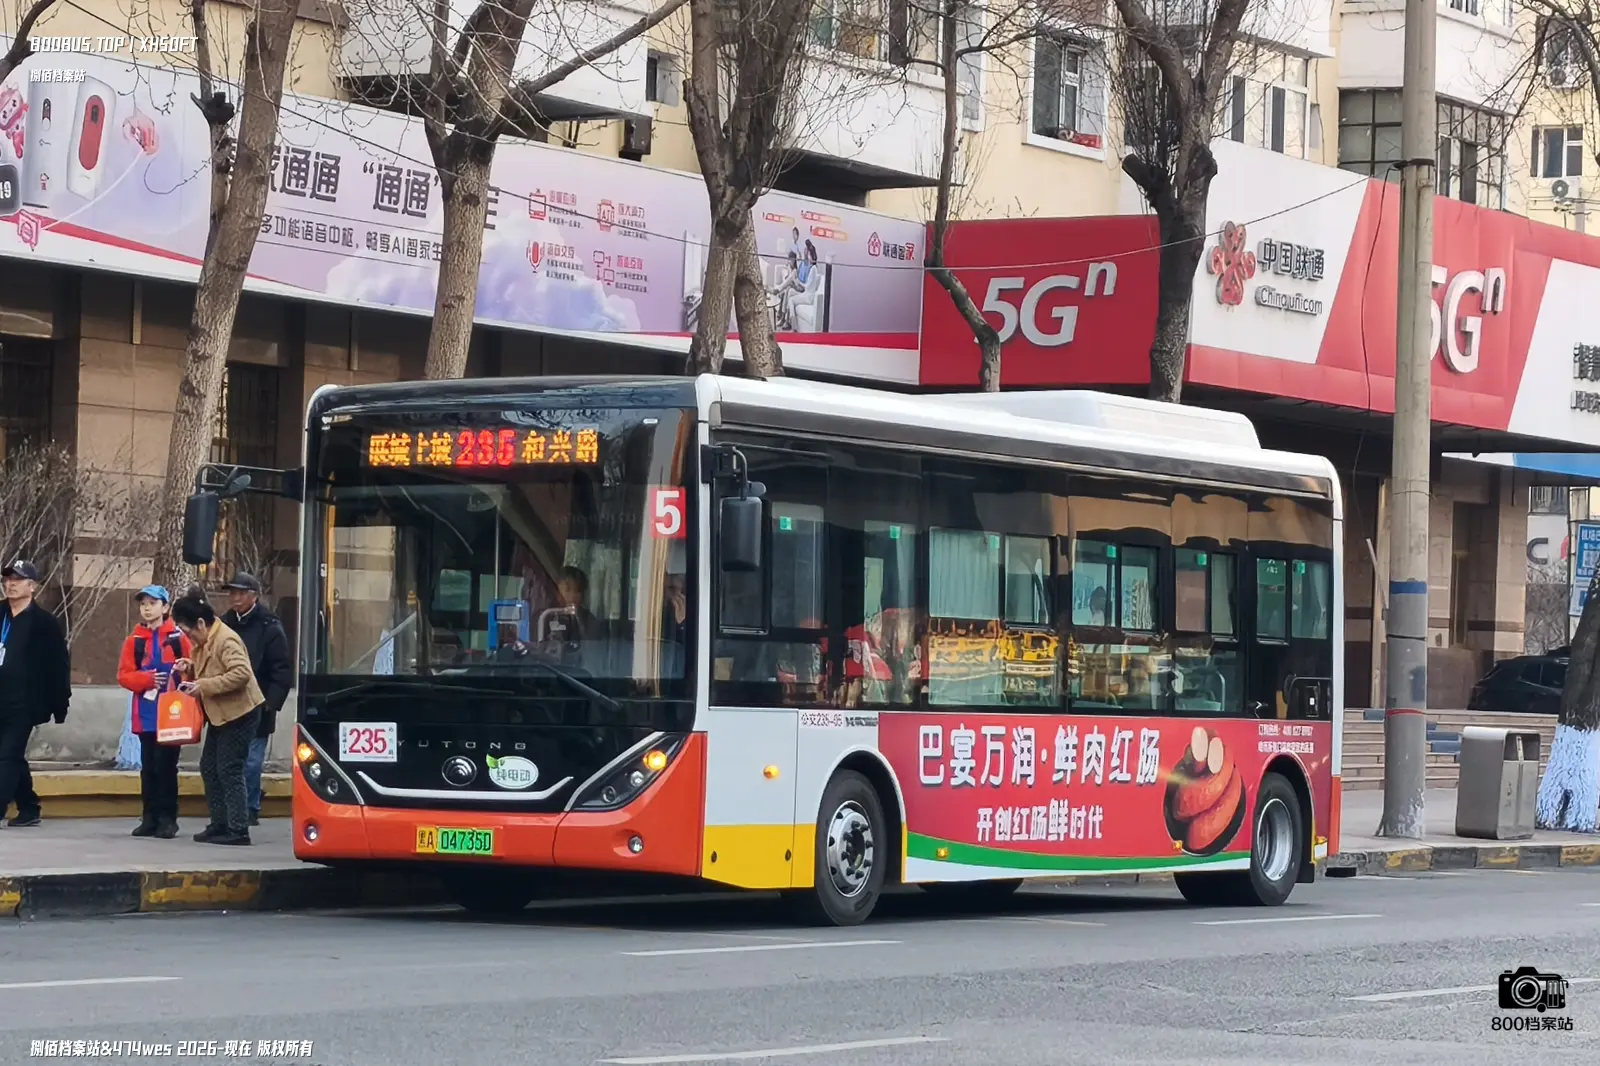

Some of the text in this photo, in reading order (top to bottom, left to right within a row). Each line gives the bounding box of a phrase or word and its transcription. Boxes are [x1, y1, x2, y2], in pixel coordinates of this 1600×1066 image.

[270, 146, 341, 203] 通通
[1258, 238, 1325, 281] 中国联通
[456, 429, 517, 466] 235
[655, 490, 681, 535] 5
[348, 727, 387, 754] 235
[919, 723, 1161, 787] 巴宴万润·鲜肉红肠
[496, 768, 531, 782] 纯电动
[976, 798, 1104, 843] 开创红肠鲜时代
